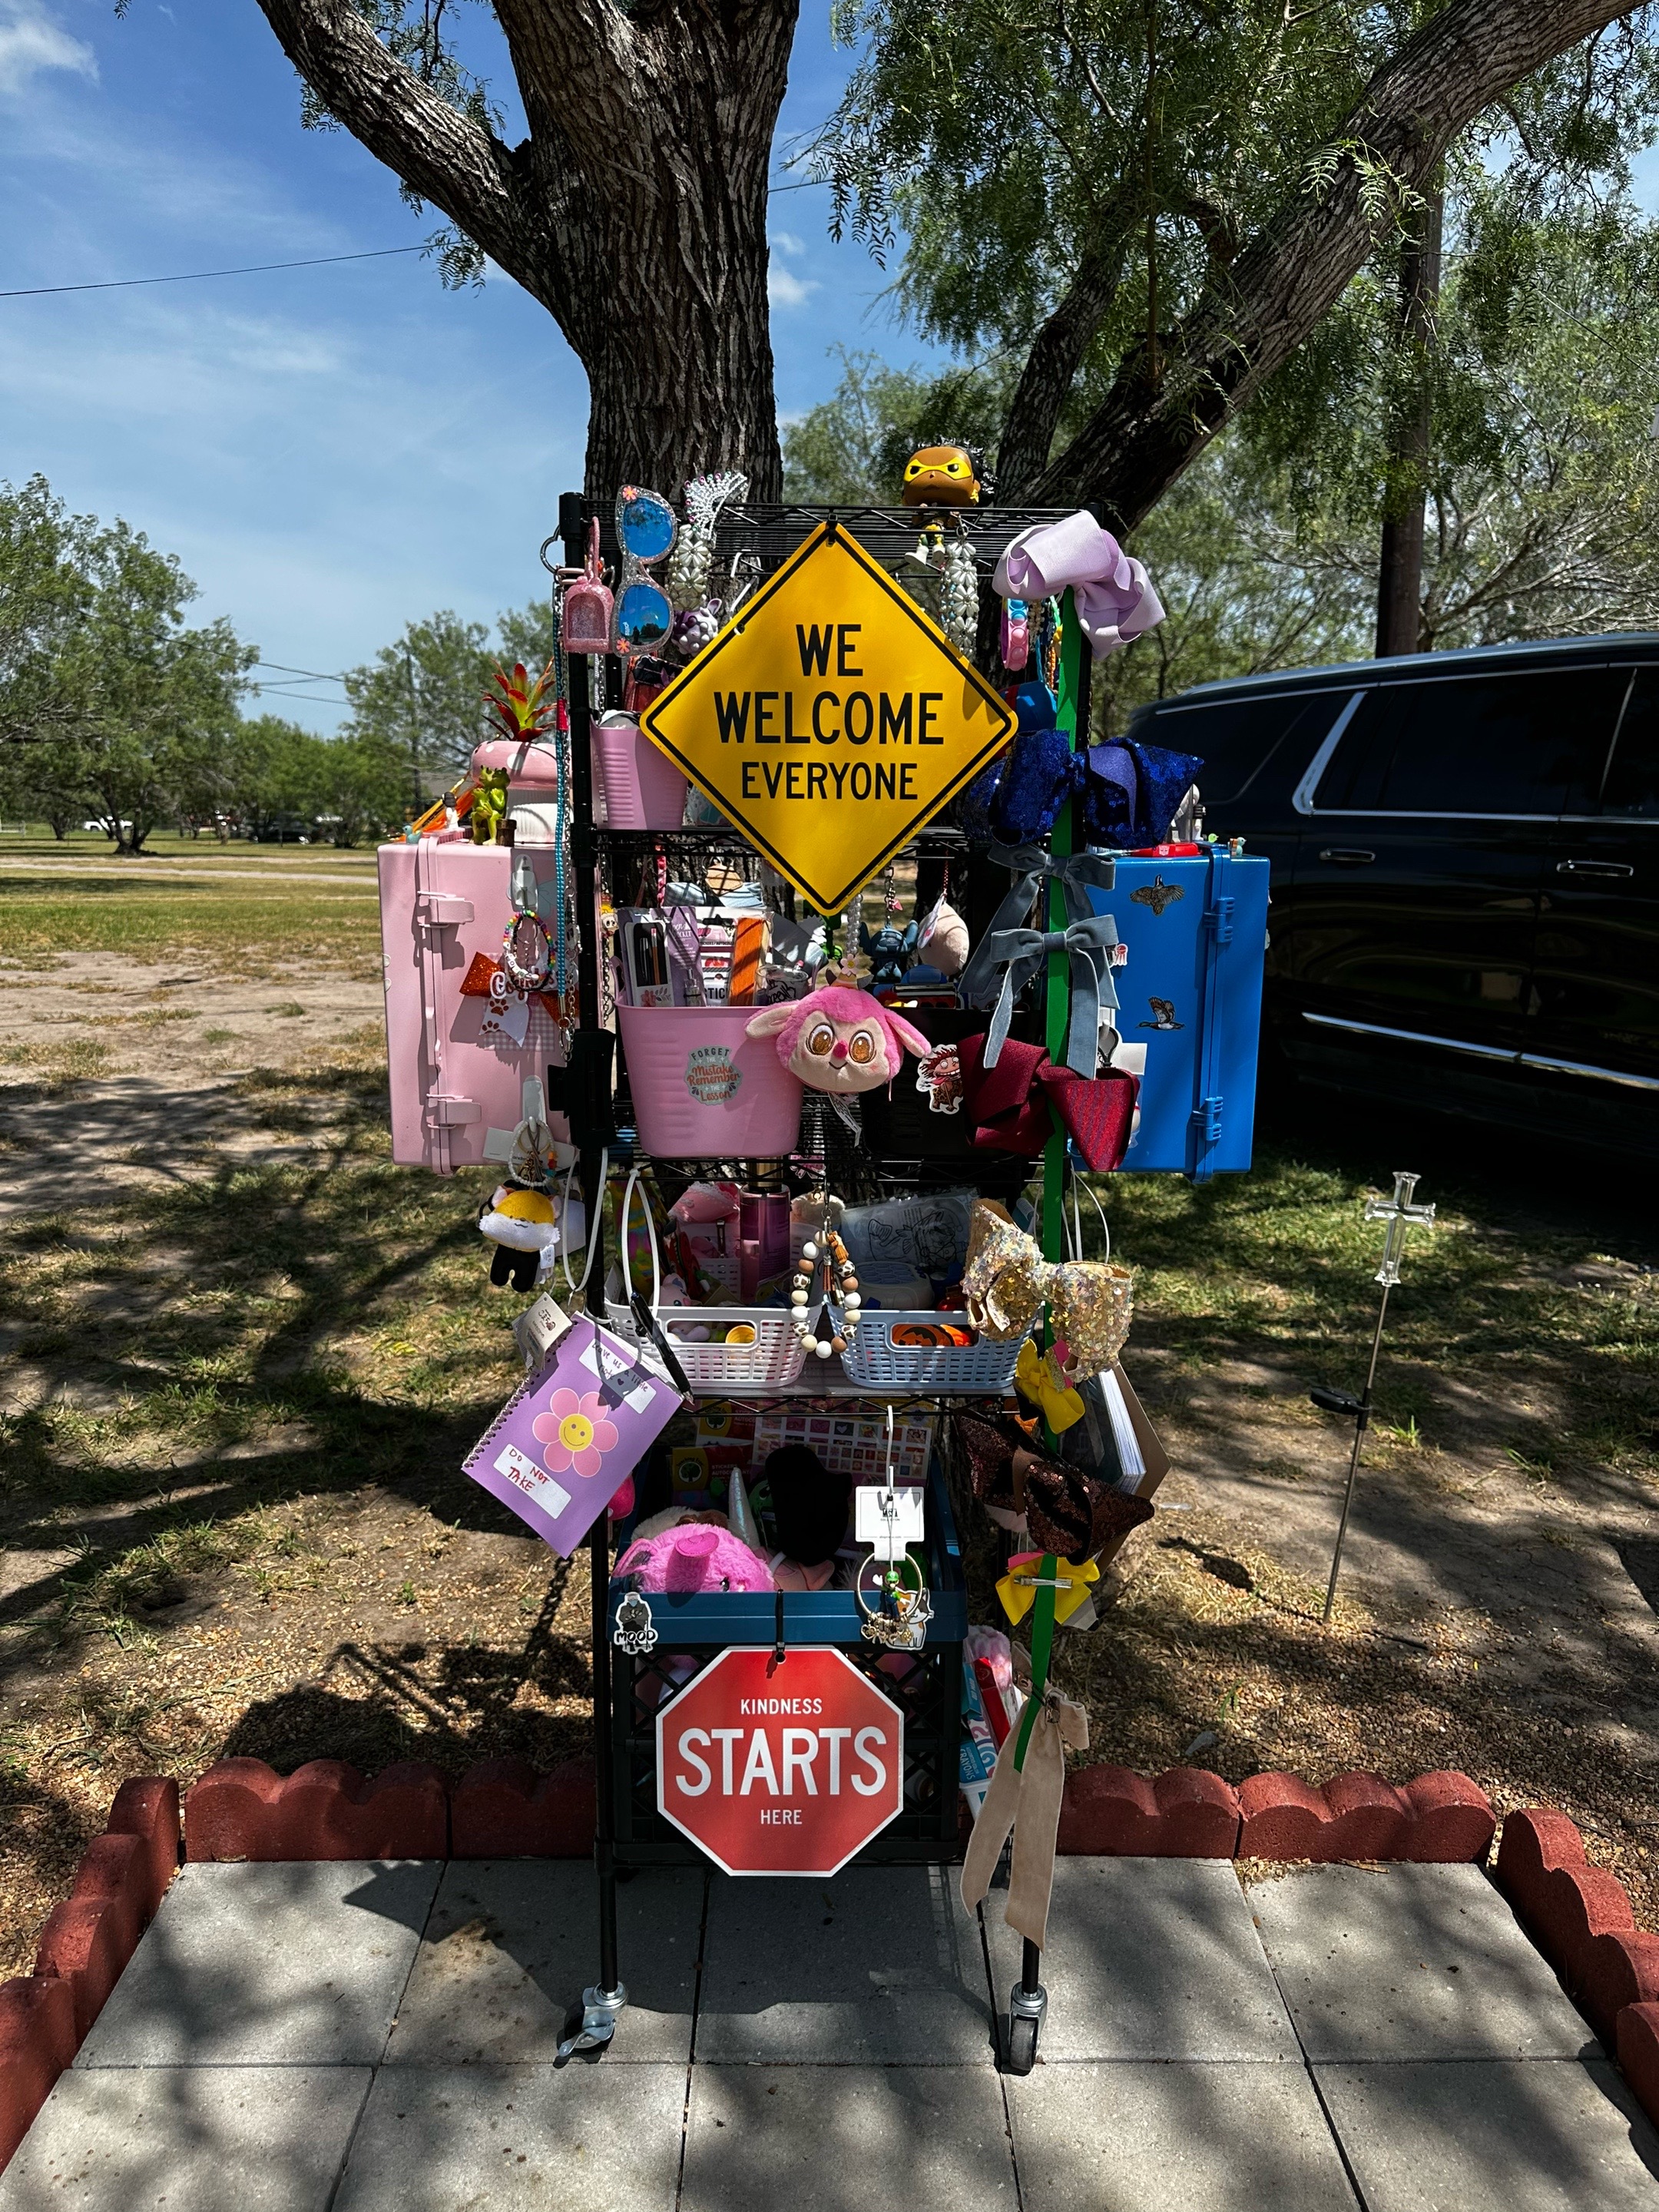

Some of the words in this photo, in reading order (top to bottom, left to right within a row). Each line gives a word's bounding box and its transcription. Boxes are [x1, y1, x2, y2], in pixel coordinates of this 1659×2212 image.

[796, 624, 863, 677] WE
[714, 690, 944, 745] WELCOME
[742, 761, 918, 800] EVERYONE
[691, 1048, 730, 1061] FORGET
[692, 1063, 734, 1077] Mistake
[687, 1073, 741, 1086] Remember
[700, 1090, 732, 1101] Lesson
[613, 1359, 623, 1369] us
[507, 1465, 536, 1492] TAKE
[529, 1465, 551, 1485] NOT
[617, 1630, 656, 1643] MOOD
[740, 1698, 823, 1715] KINDNESS
[676, 1727, 887, 1796] STARTS
[760, 1809, 803, 1825] HERE
